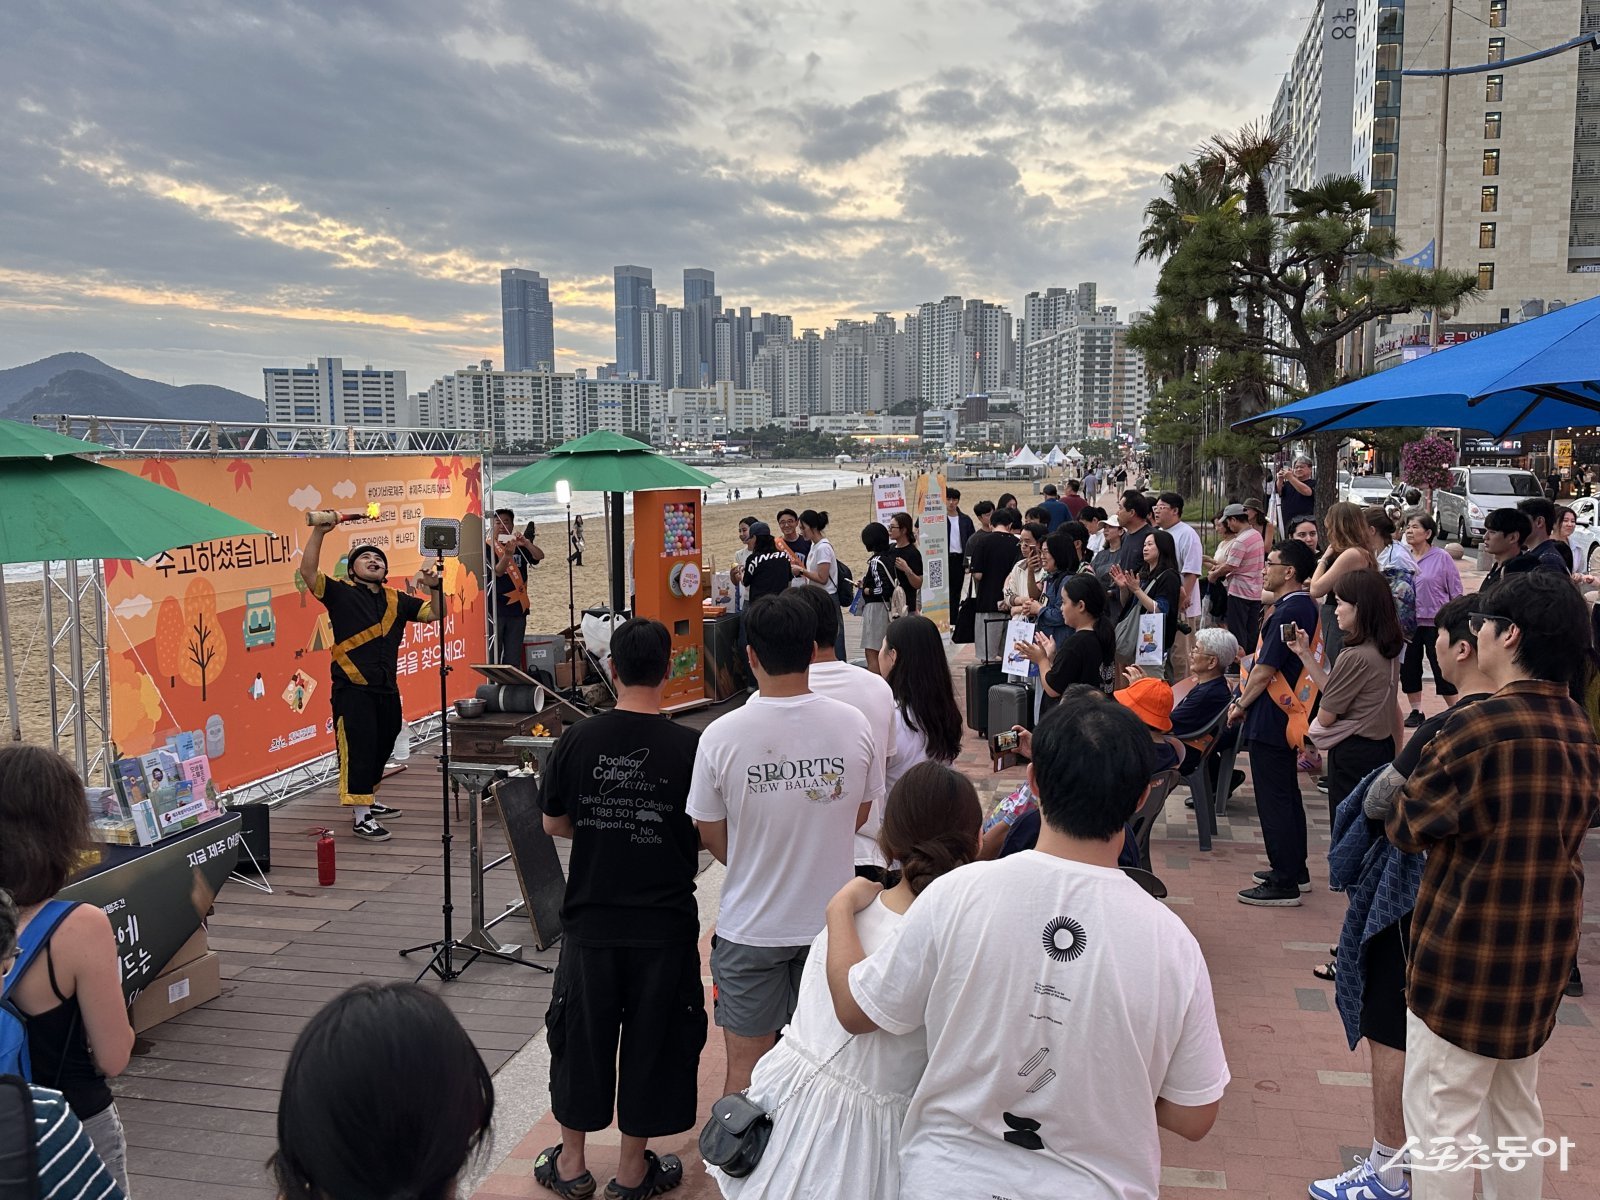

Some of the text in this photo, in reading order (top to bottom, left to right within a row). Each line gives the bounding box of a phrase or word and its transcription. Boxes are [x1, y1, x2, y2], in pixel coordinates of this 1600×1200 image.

[1332, 8, 1357, 23] AP
[748, 757, 845, 784] SPORTS
[749, 777, 844, 794] NEW BALANCE
[641, 827, 654, 836] No
[187, 850, 207, 868] 지금
[208, 843, 227, 859] 제주
